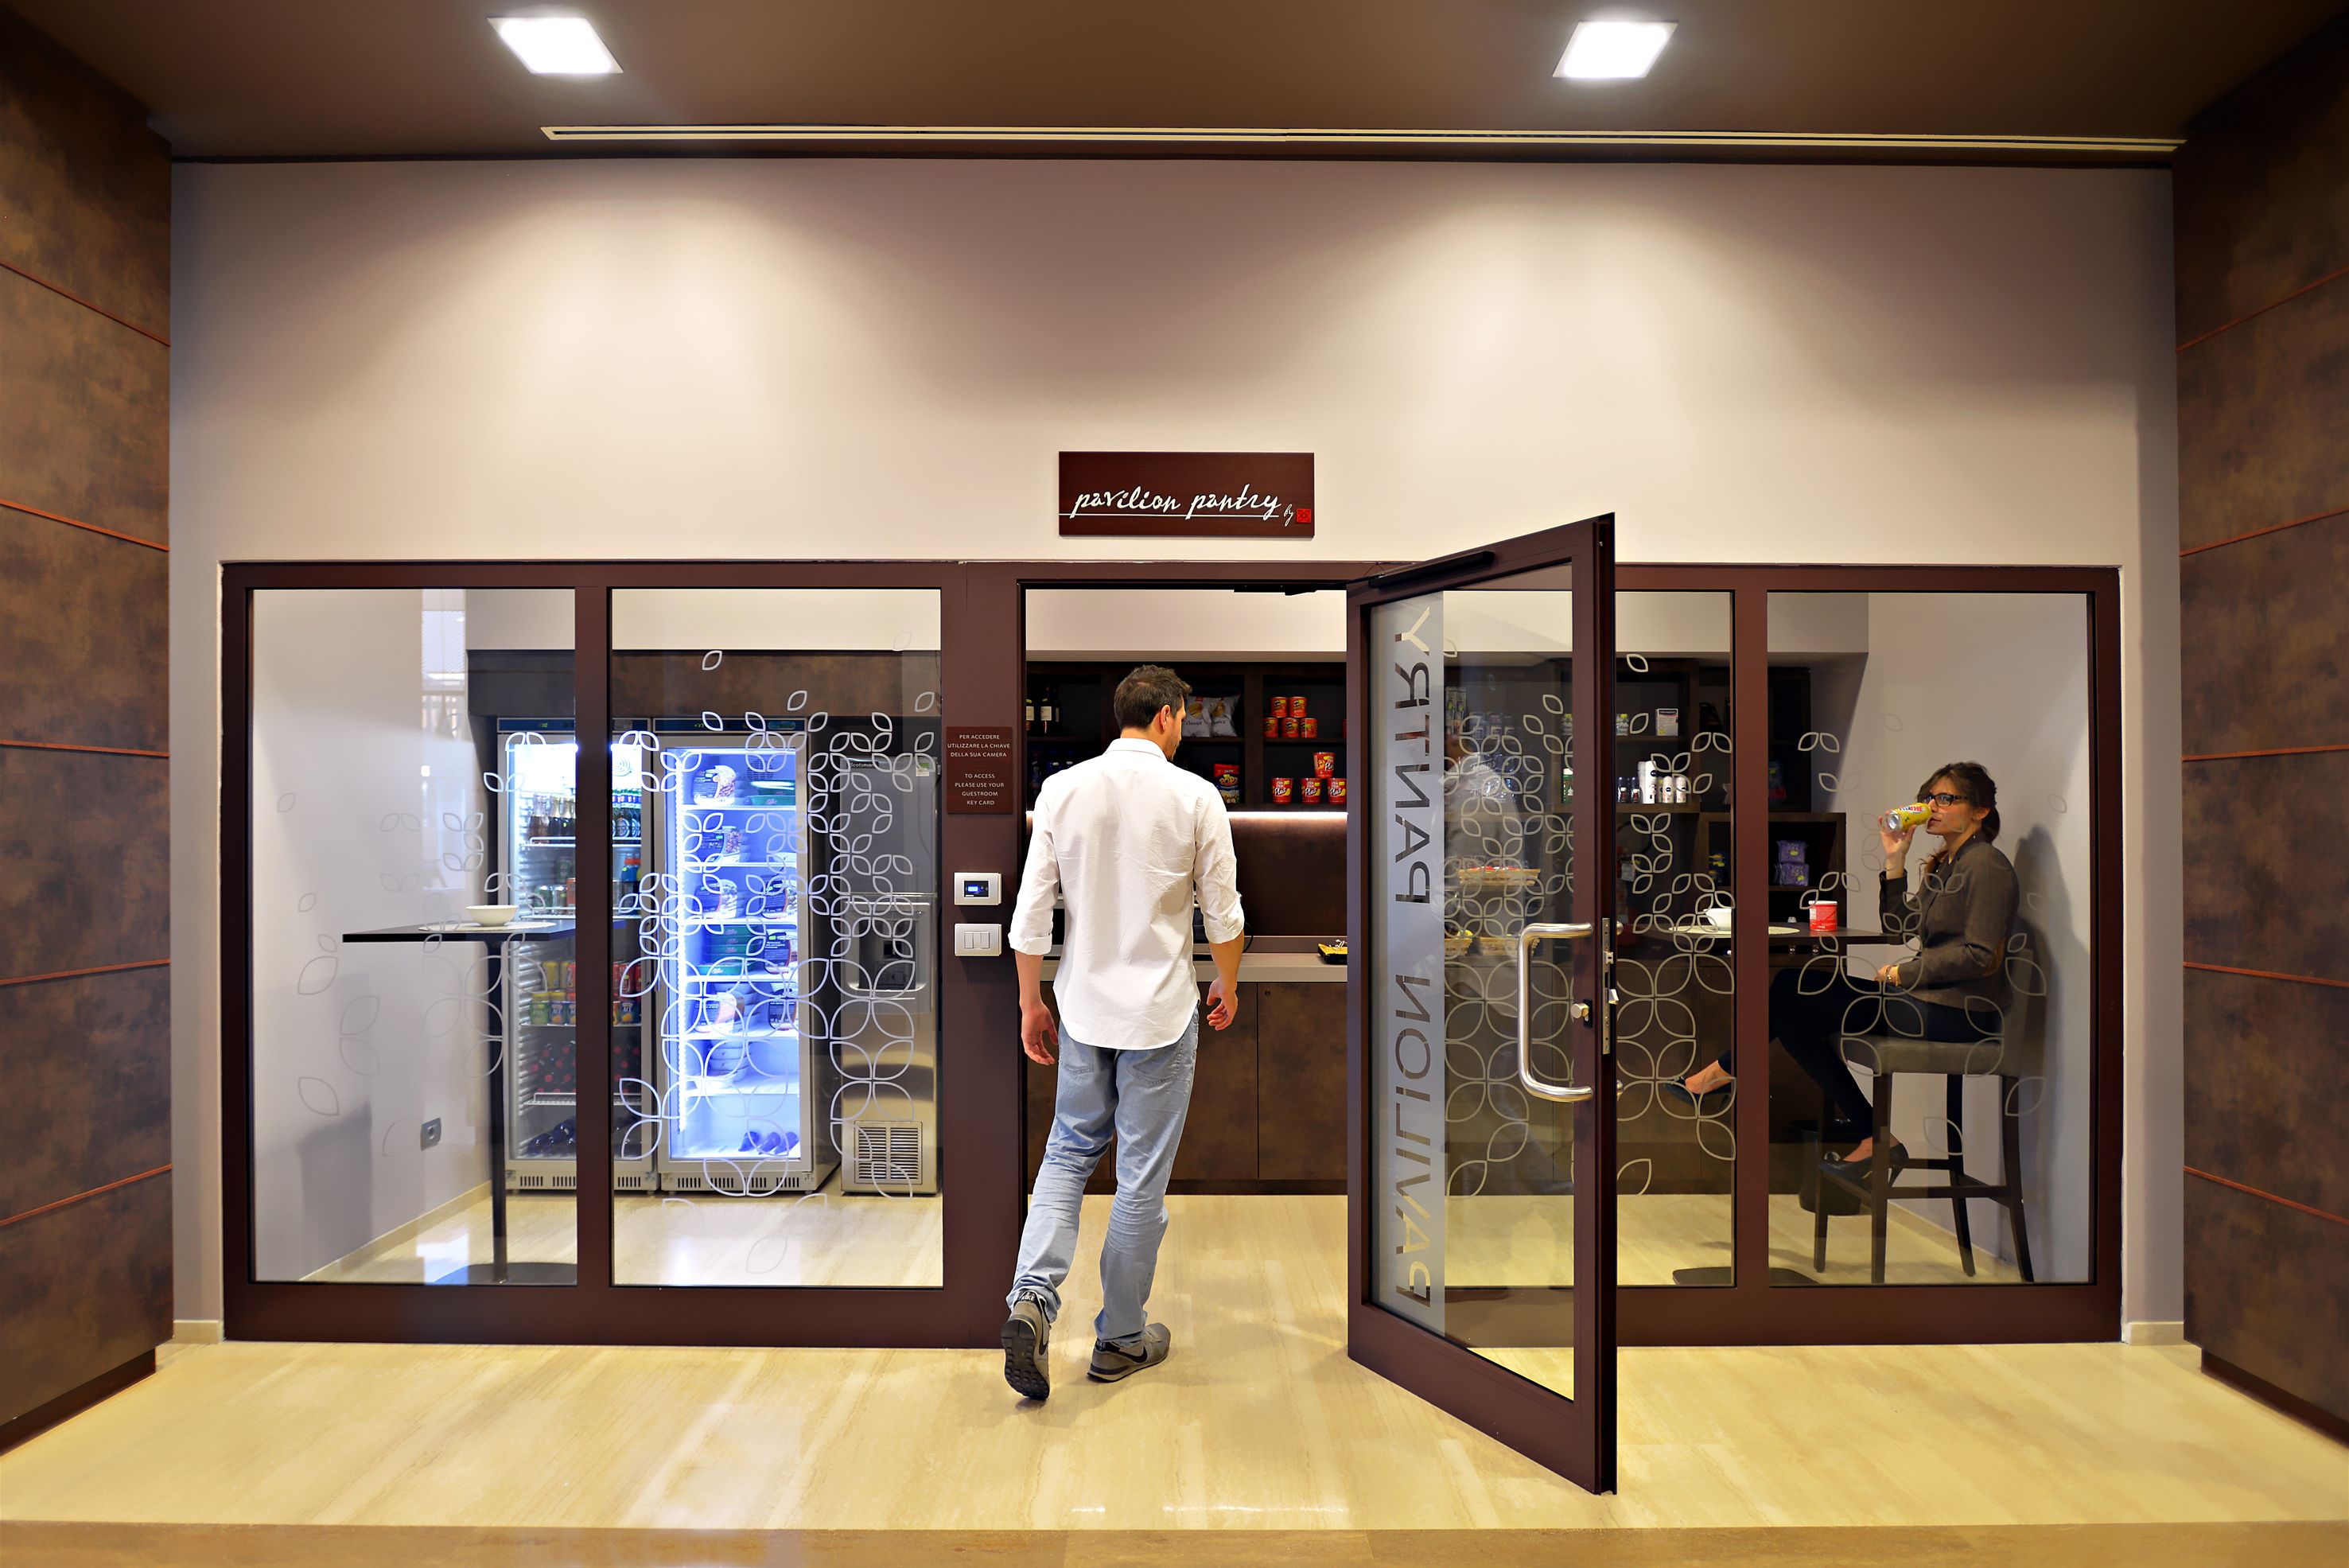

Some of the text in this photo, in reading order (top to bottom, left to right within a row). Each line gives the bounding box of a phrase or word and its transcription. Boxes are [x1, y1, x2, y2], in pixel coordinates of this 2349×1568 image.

[1069, 484, 1295, 527] pavilion pantry by
